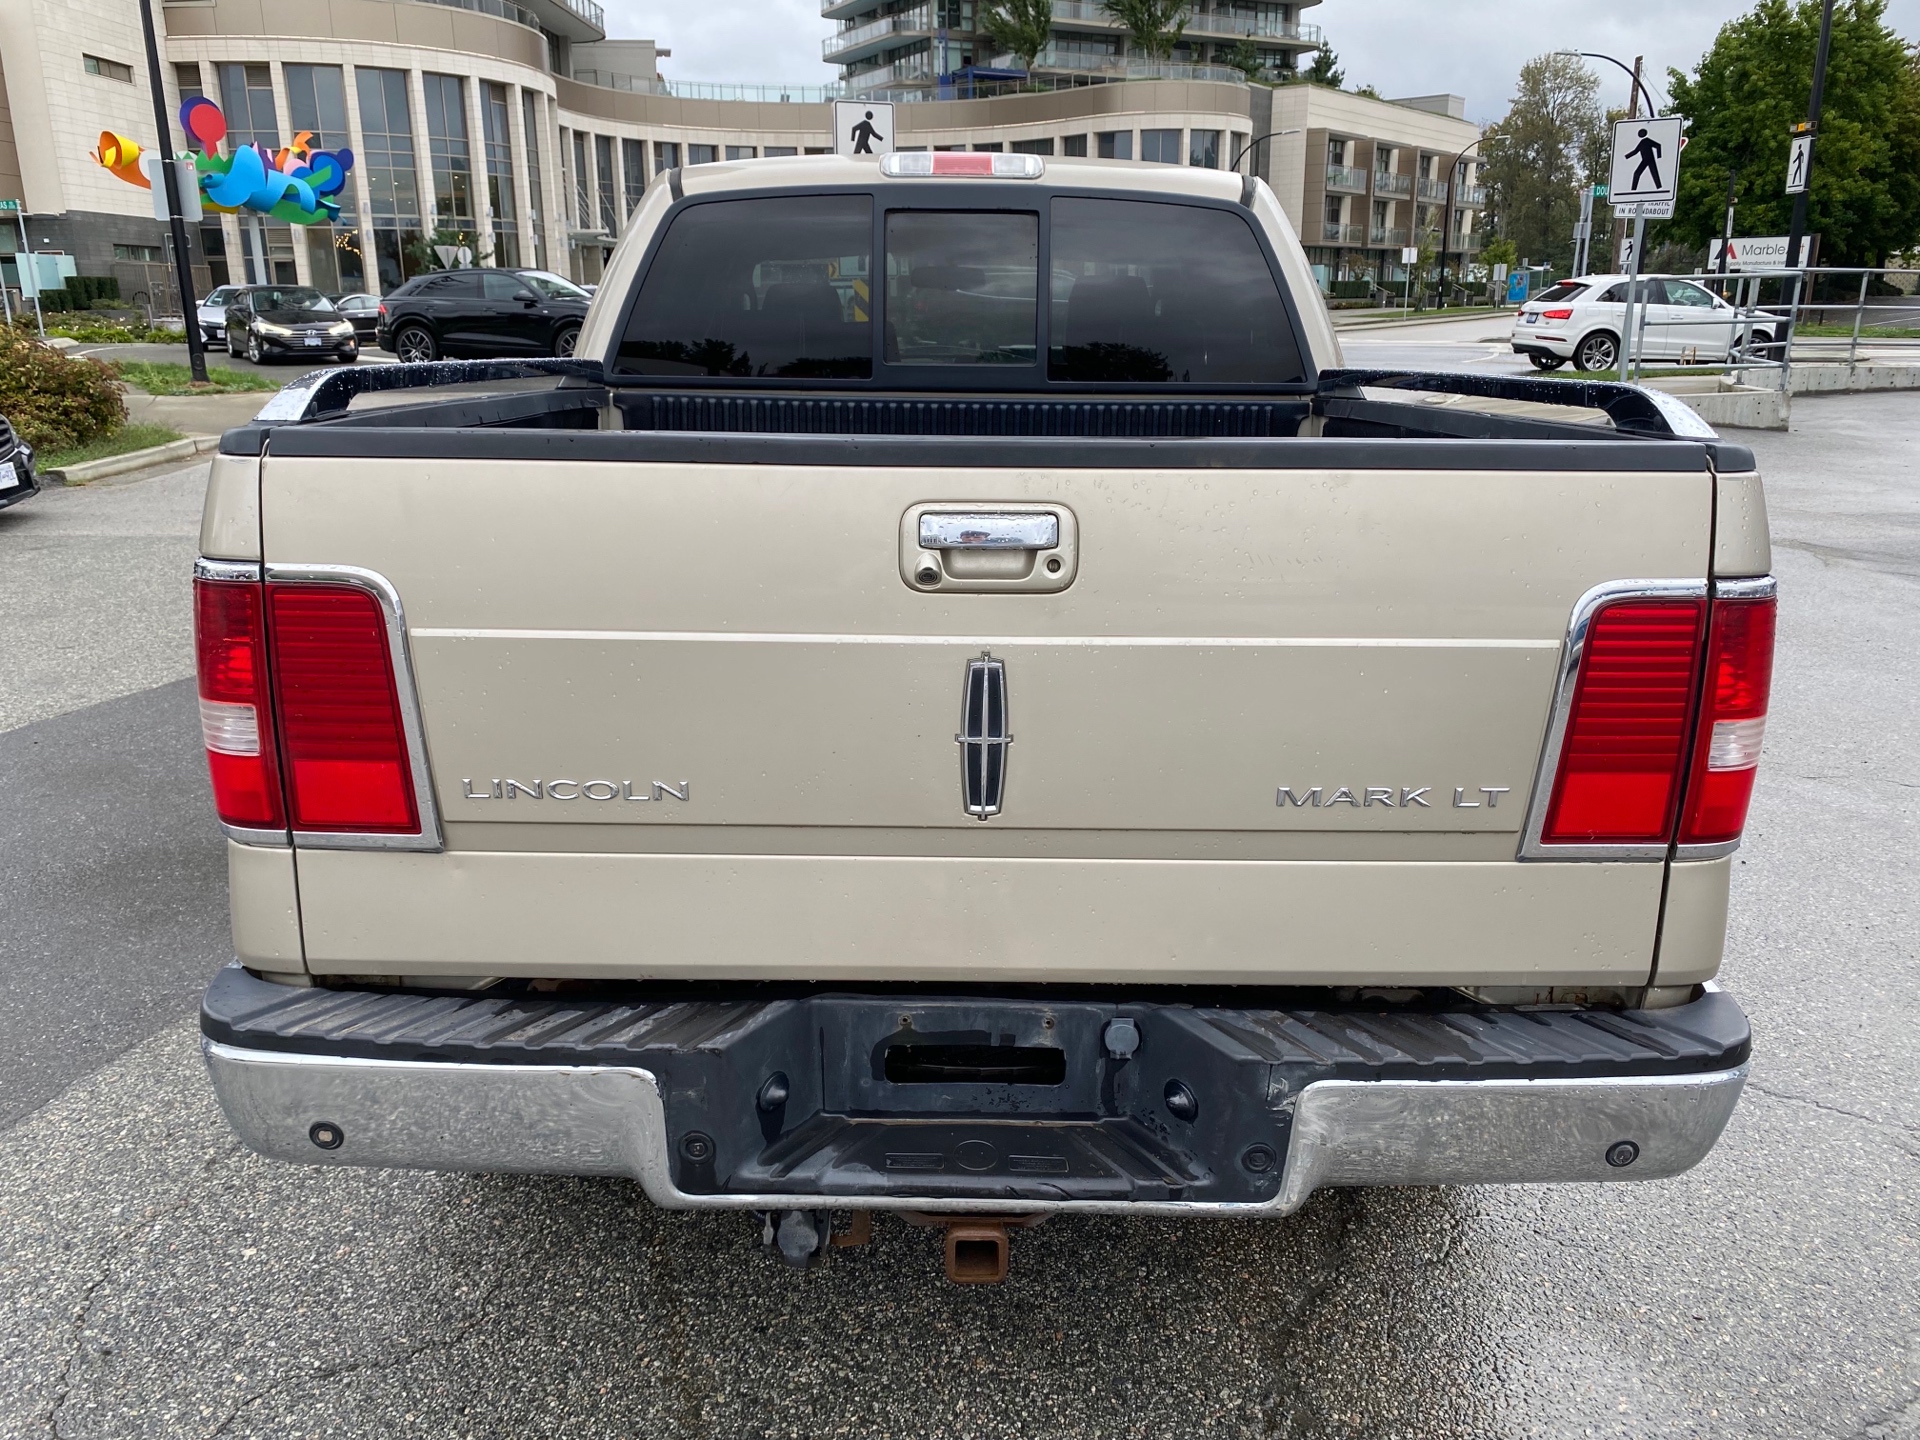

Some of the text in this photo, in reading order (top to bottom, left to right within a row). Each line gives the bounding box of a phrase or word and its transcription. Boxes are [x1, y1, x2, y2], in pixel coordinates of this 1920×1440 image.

[1628, 207, 1670, 215] RONDABOUT
[462, 778, 690, 802] LINCOLN
[1276, 786, 1511, 808] MARK LT
